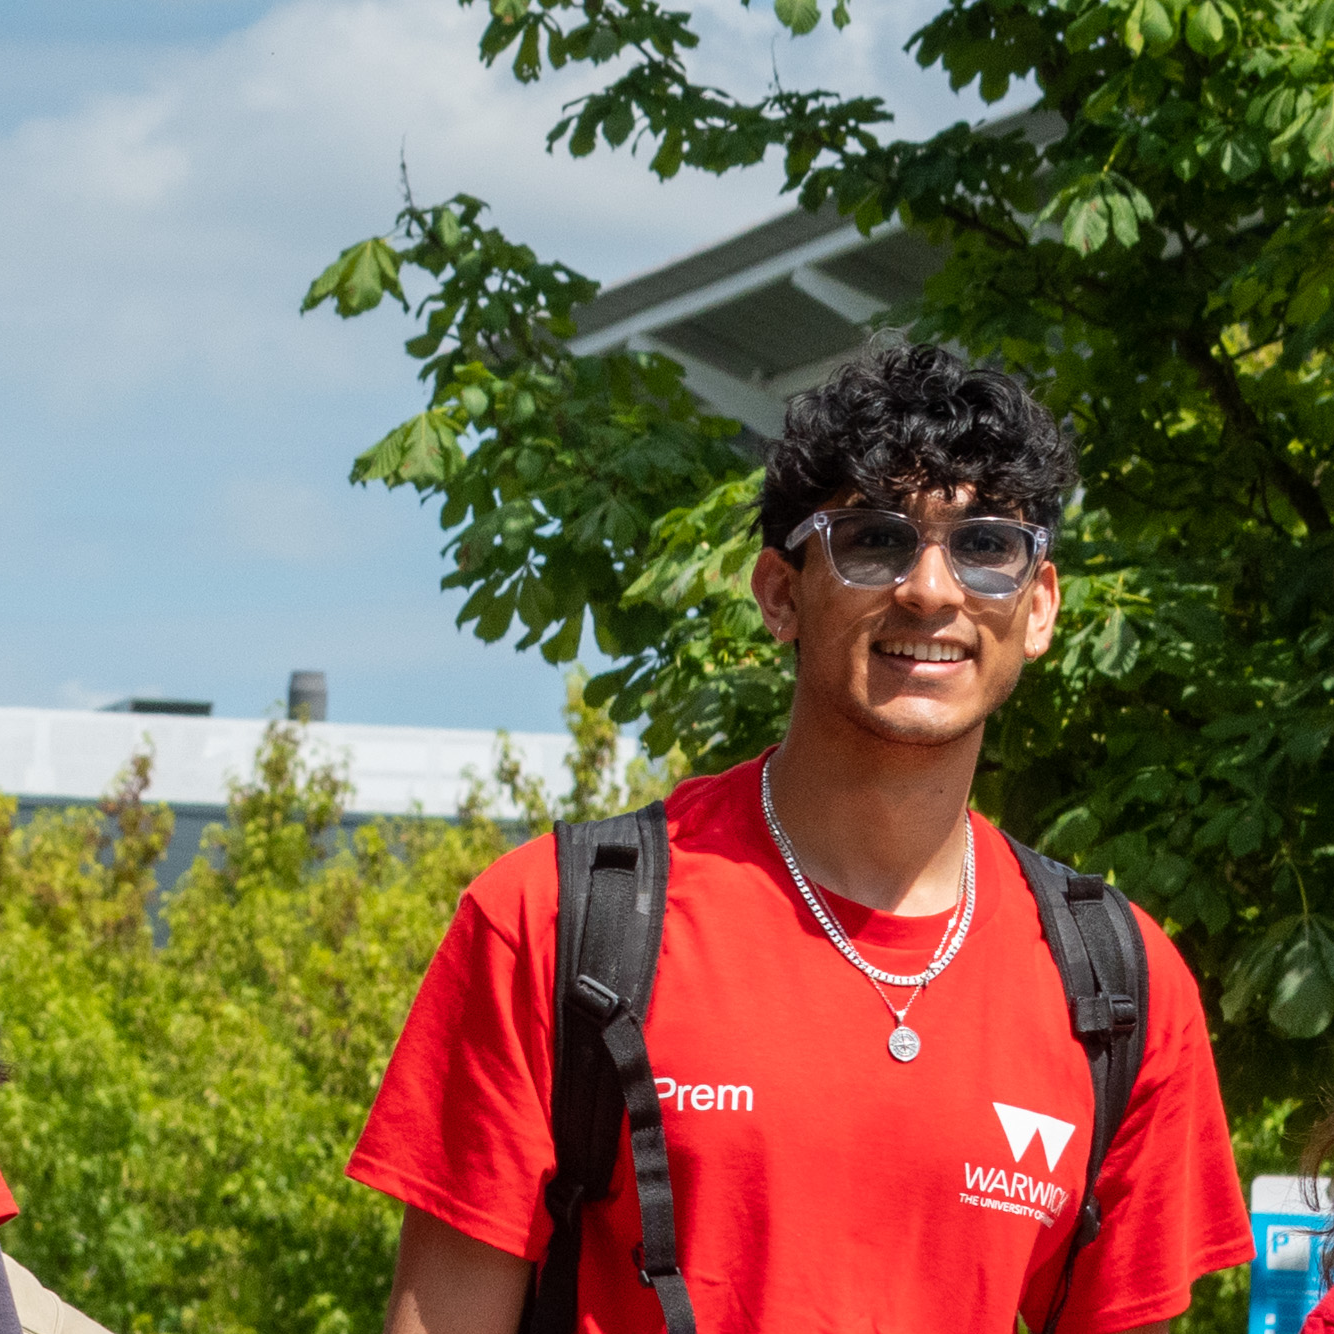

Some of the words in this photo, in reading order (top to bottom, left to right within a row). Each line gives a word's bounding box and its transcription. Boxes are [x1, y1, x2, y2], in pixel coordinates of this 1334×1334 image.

[653, 1077, 754, 1111] Prem
[964, 1162, 1069, 1217] WARWICK
[959, 1192, 980, 1207] THE
[980, 1198, 1035, 1218] UNIVERSITY
[1273, 1232, 1289, 1254] P
